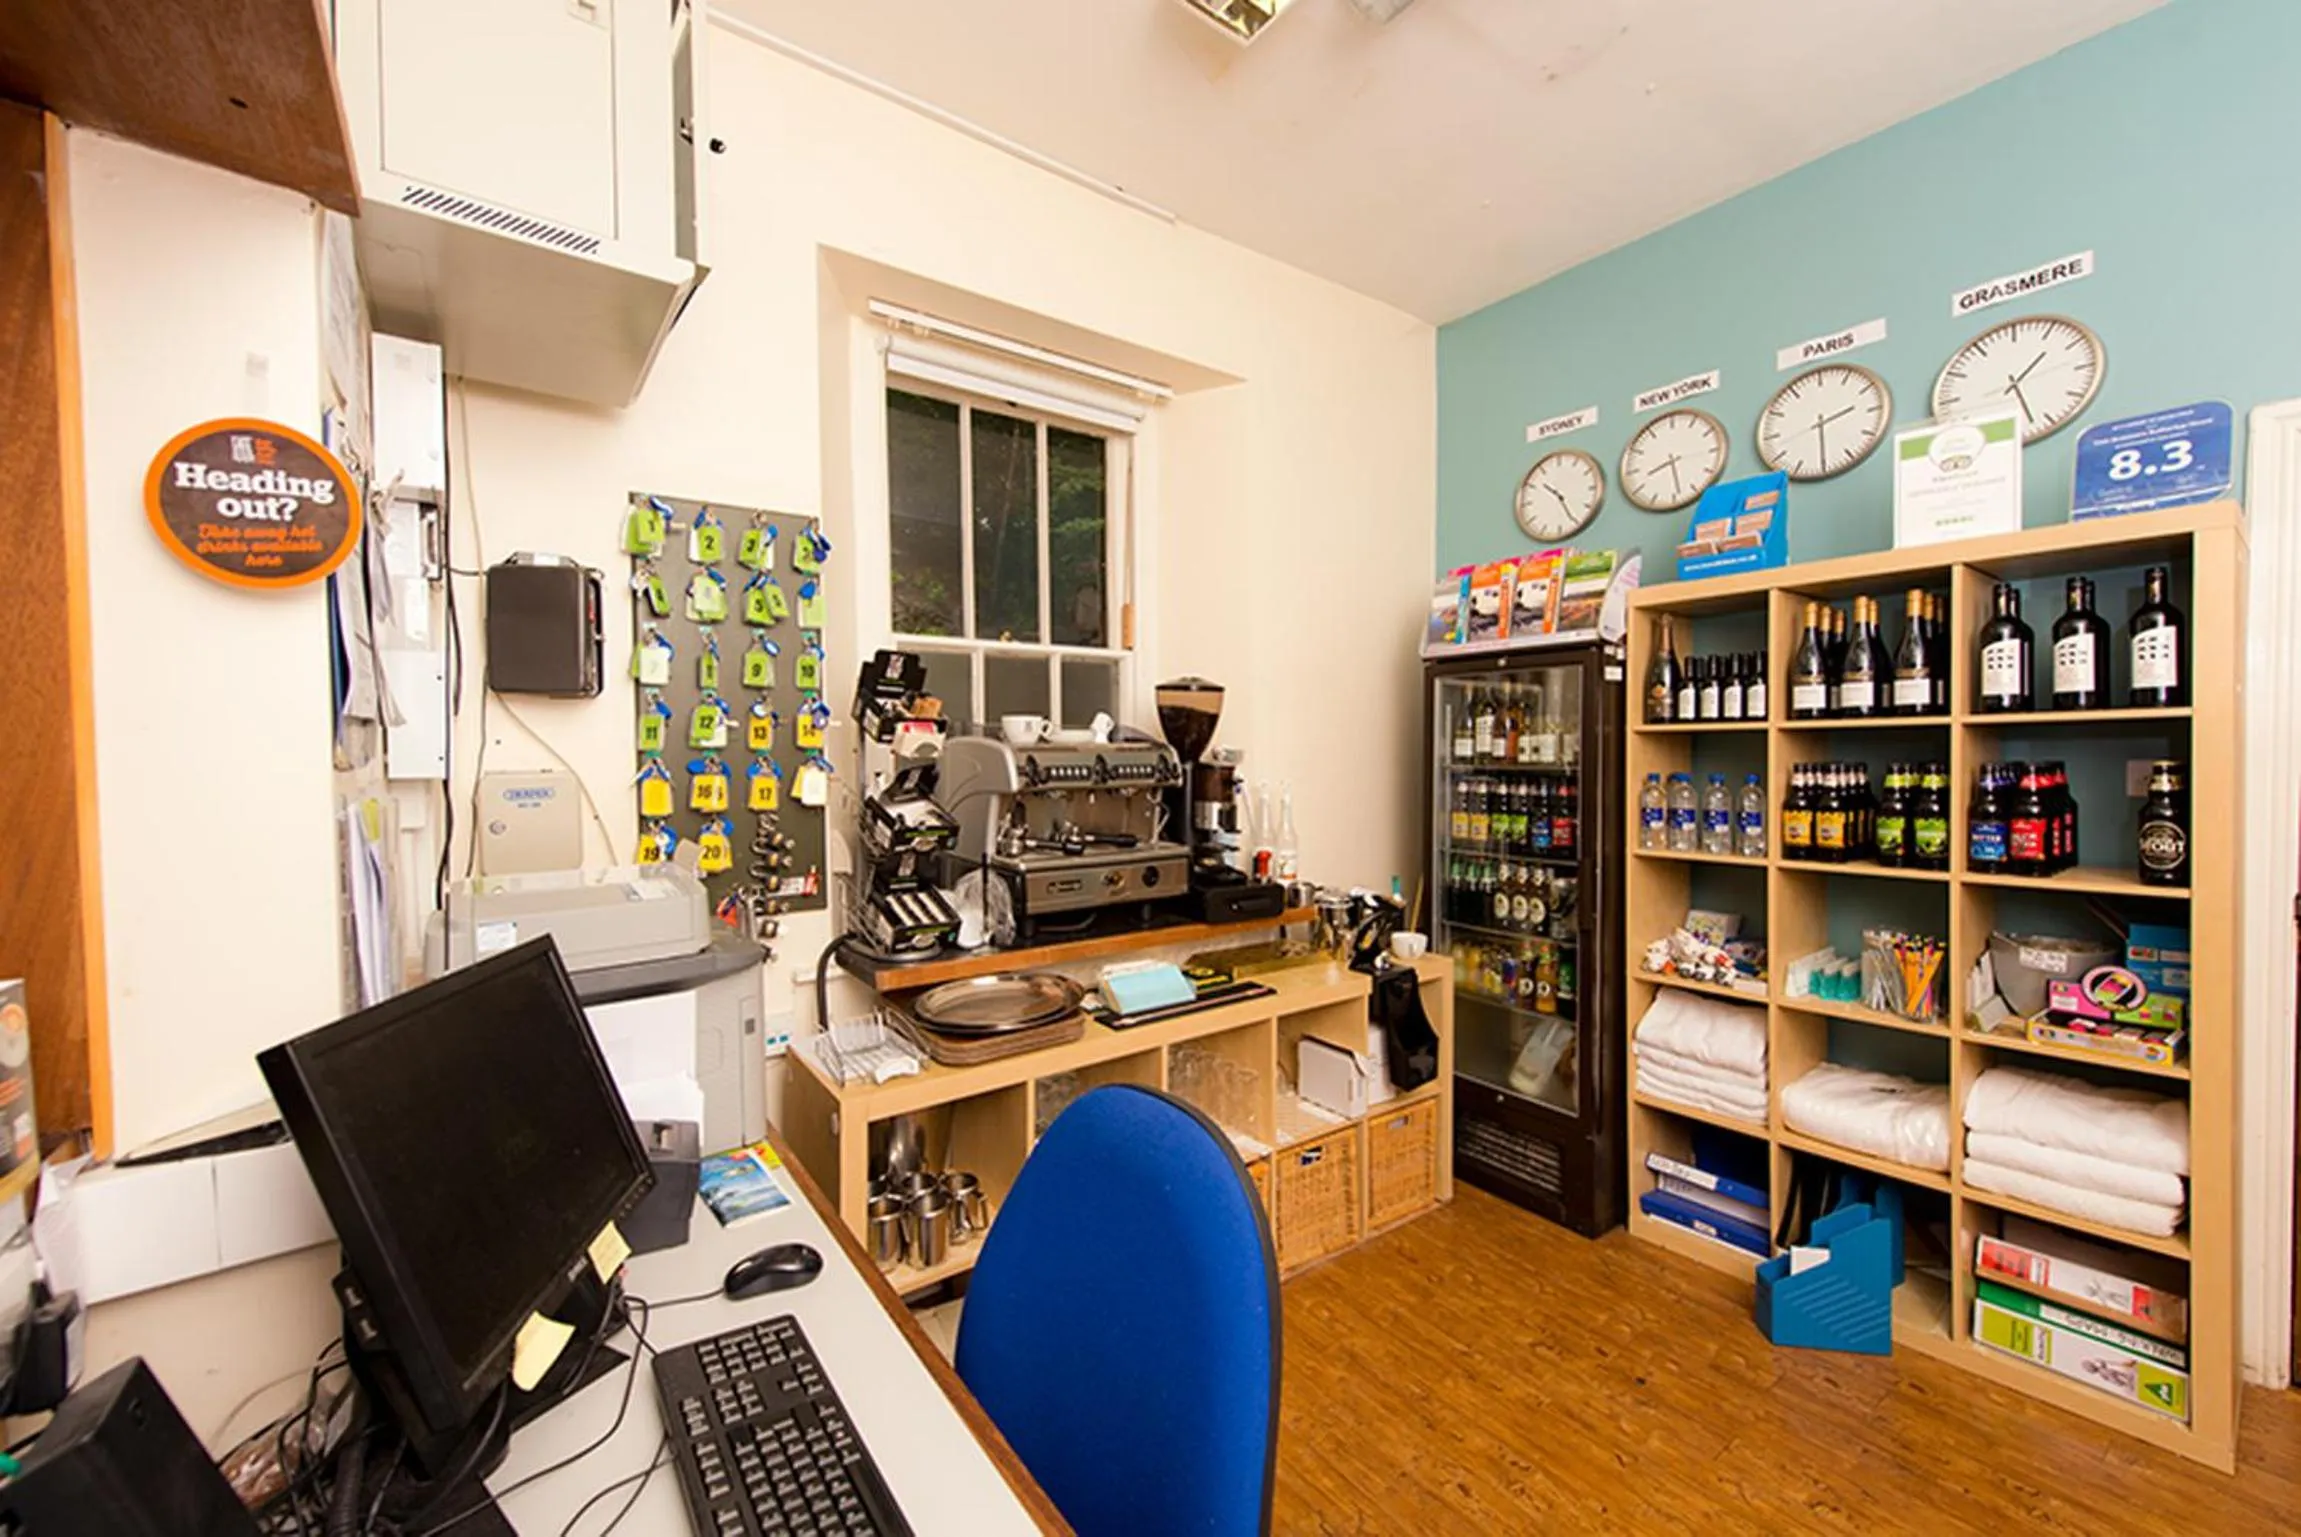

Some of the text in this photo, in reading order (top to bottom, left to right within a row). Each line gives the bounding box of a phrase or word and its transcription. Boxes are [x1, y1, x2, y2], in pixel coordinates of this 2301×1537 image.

[1959, 258, 2084, 310] GRASMERE
[1803, 332, 1854, 358] PARIS
[1640, 376, 1711, 407] NEW YORK
[1539, 414, 1584, 436] SYDNEY
[2108, 440, 2193, 481] 8.3
[174, 462, 334, 504] Heading
[216, 497, 298, 521] out?
[705, 535, 714, 550] 2
[802, 664, 815, 678] 10
[700, 714, 714, 729] 12
[646, 727, 658, 741] 11
[758, 787, 772, 801] 17
[643, 846, 660, 862] 19
[702, 845, 721, 860] 20
